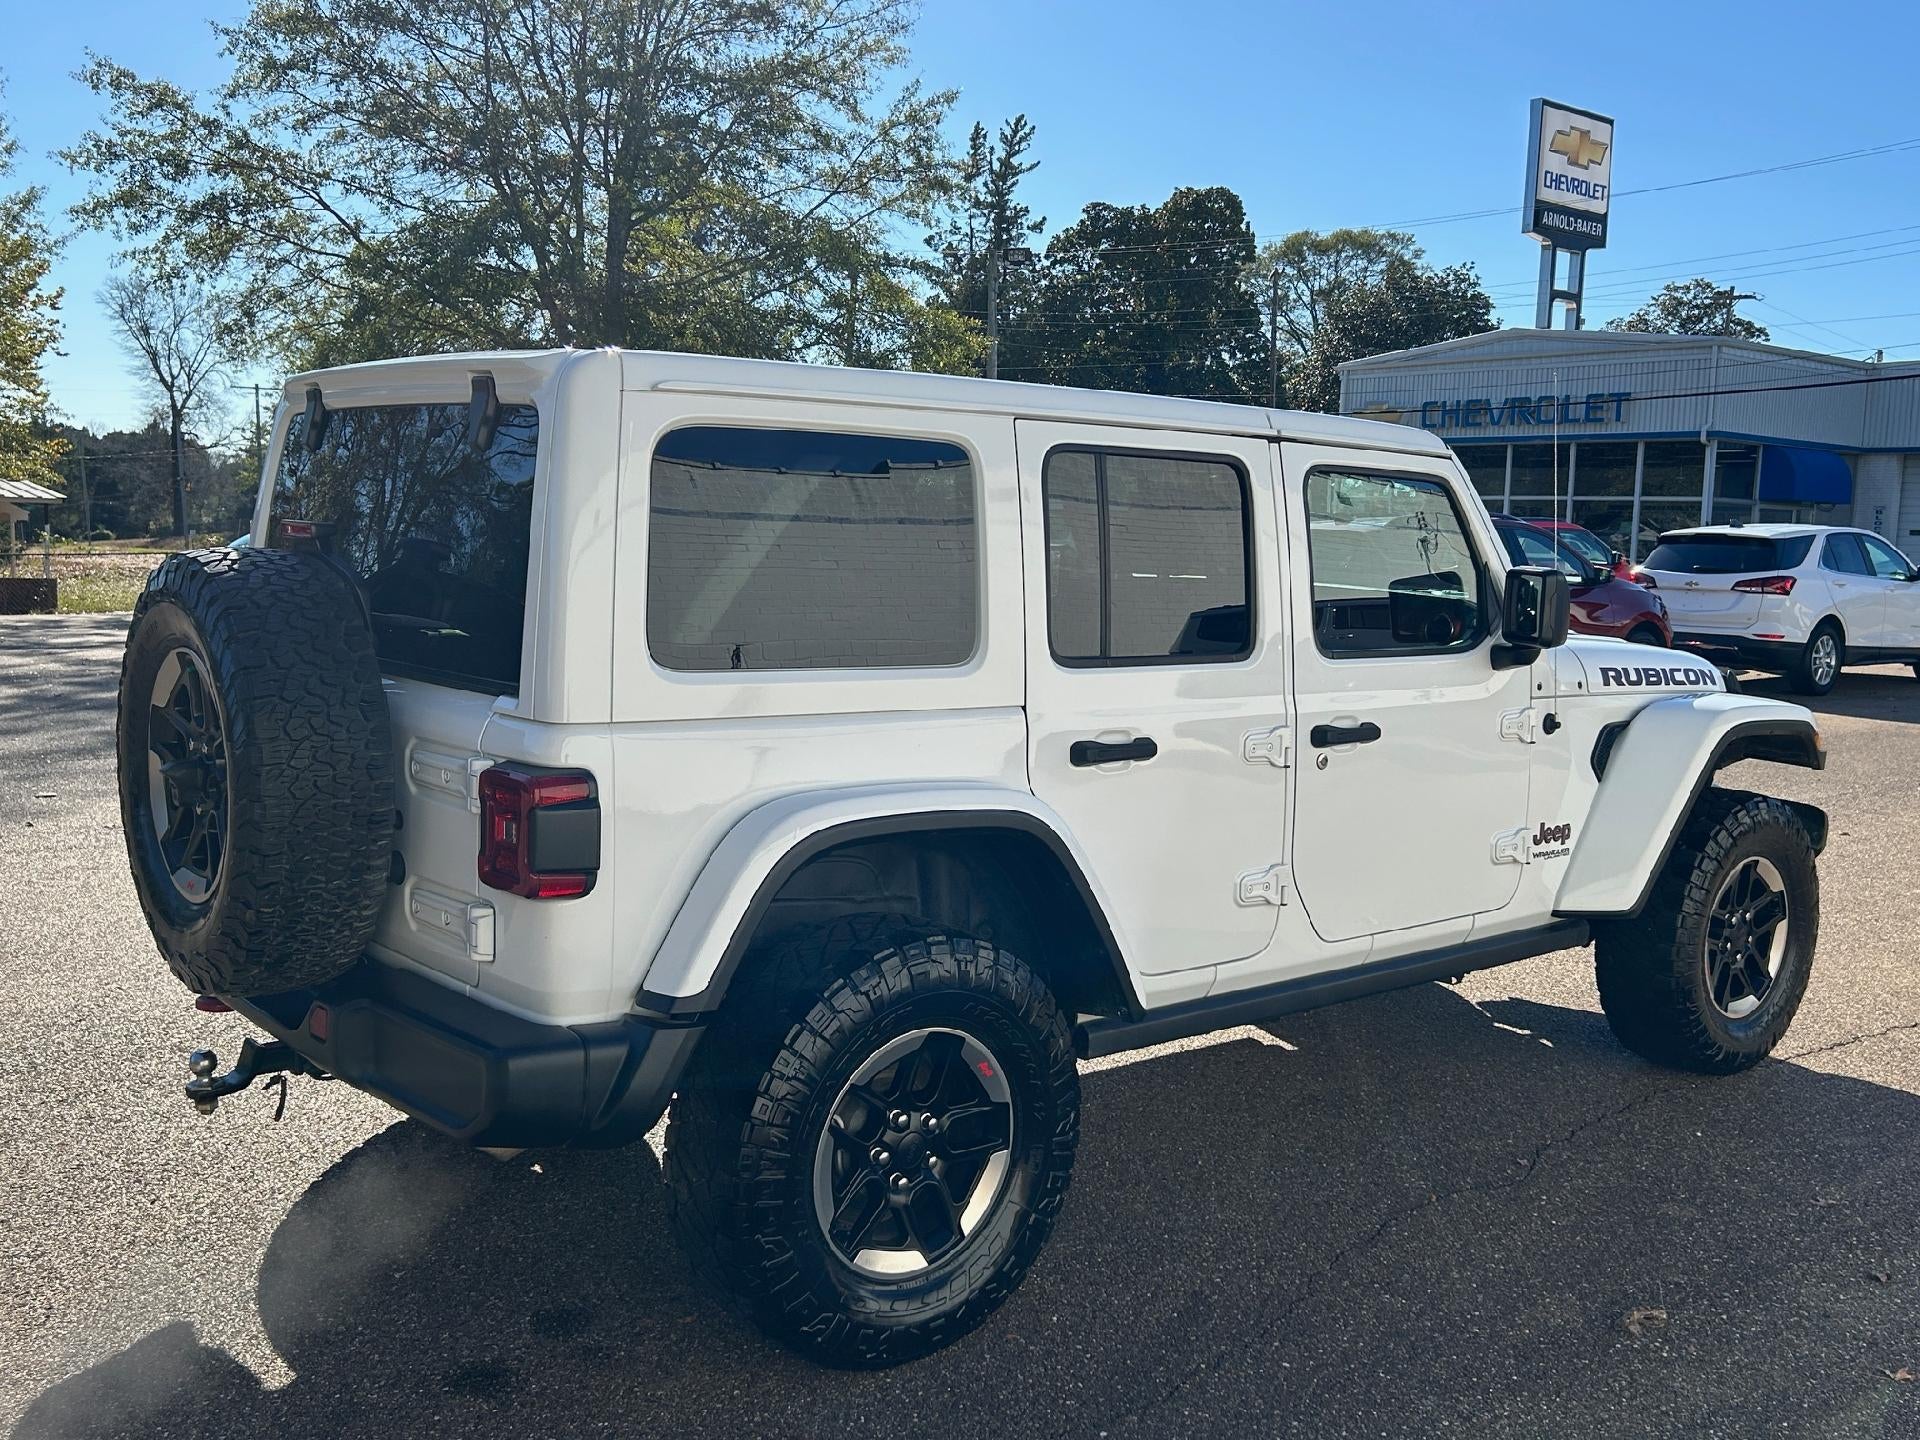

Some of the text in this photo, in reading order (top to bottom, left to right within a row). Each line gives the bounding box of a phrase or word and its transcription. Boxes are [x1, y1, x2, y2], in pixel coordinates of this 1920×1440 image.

[1543, 169, 1607, 202] CHEVROLET
[1542, 210, 1603, 237] ARNOLD-BAKER
[1421, 392, 1631, 428] CHEVROLET
[1599, 667, 1717, 687] RUBICON
[1532, 822, 1571, 846] Jeep
